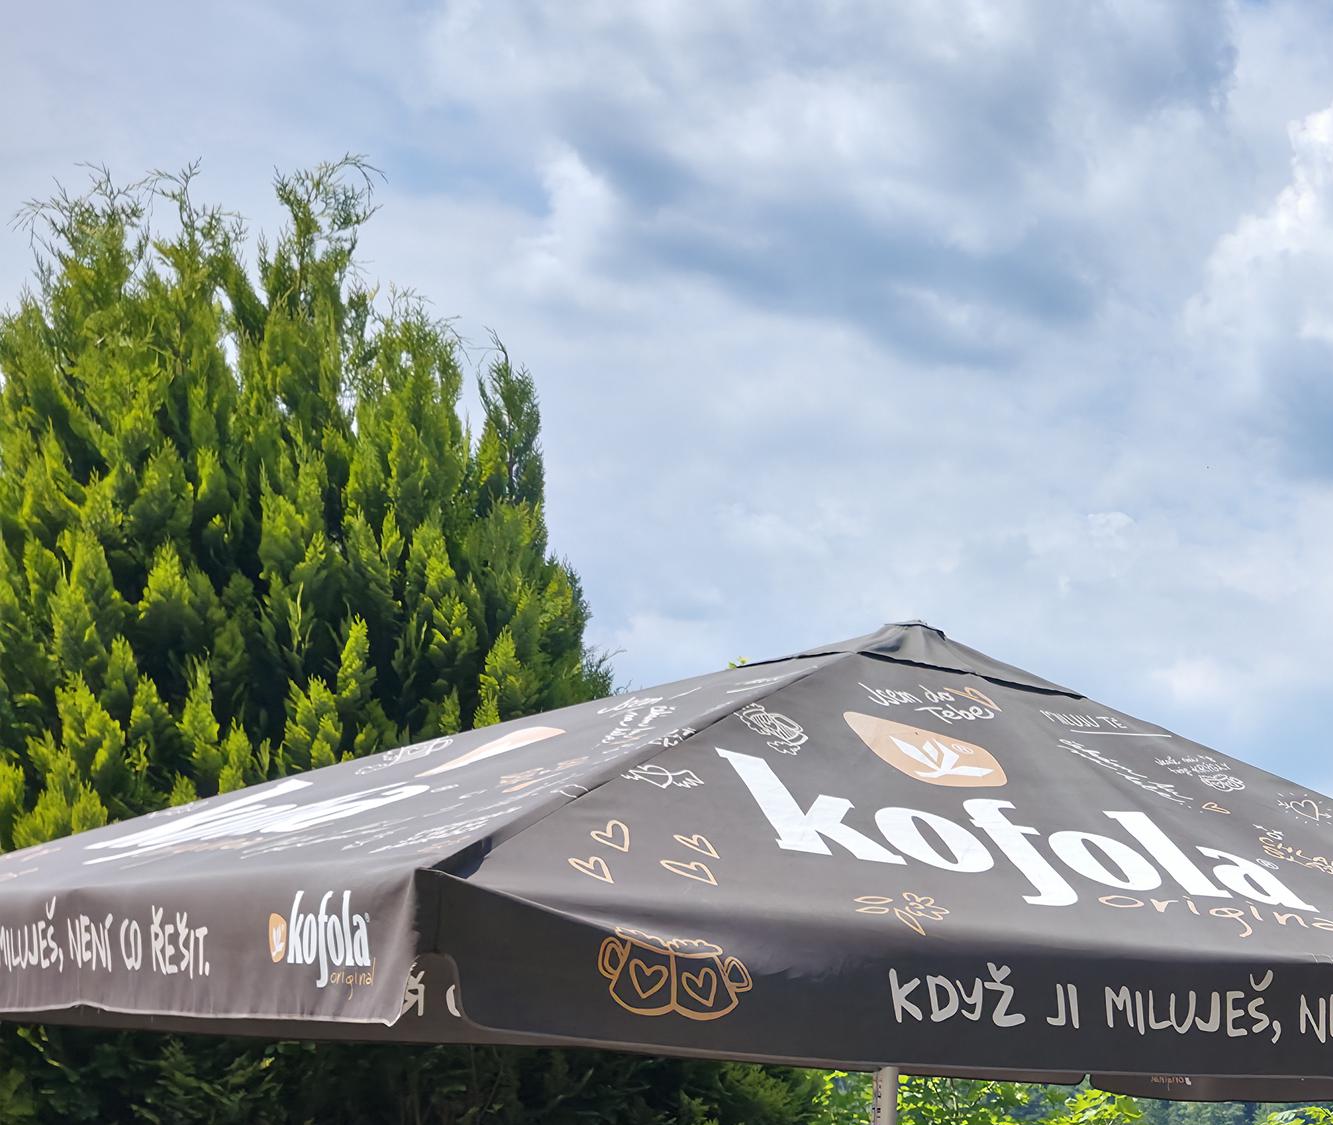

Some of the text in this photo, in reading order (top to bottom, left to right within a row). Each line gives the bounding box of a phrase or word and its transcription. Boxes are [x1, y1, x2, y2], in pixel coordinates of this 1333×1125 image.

[858, 682, 955, 706] Jsem do
[714, 747, 1319, 907] kofola
[67, 912, 113, 972] NENÍ
[120, 918, 142, 971] CO
[151, 904, 210, 979] ŘEŠIT.
[287, 890, 373, 988] kofola
[330, 957, 375, 1000] original
[889, 961, 1025, 1028] KDYŽ
[1046, 984, 1081, 1029] JI
[1106, 970, 1281, 1044] MILUJEŠ,
